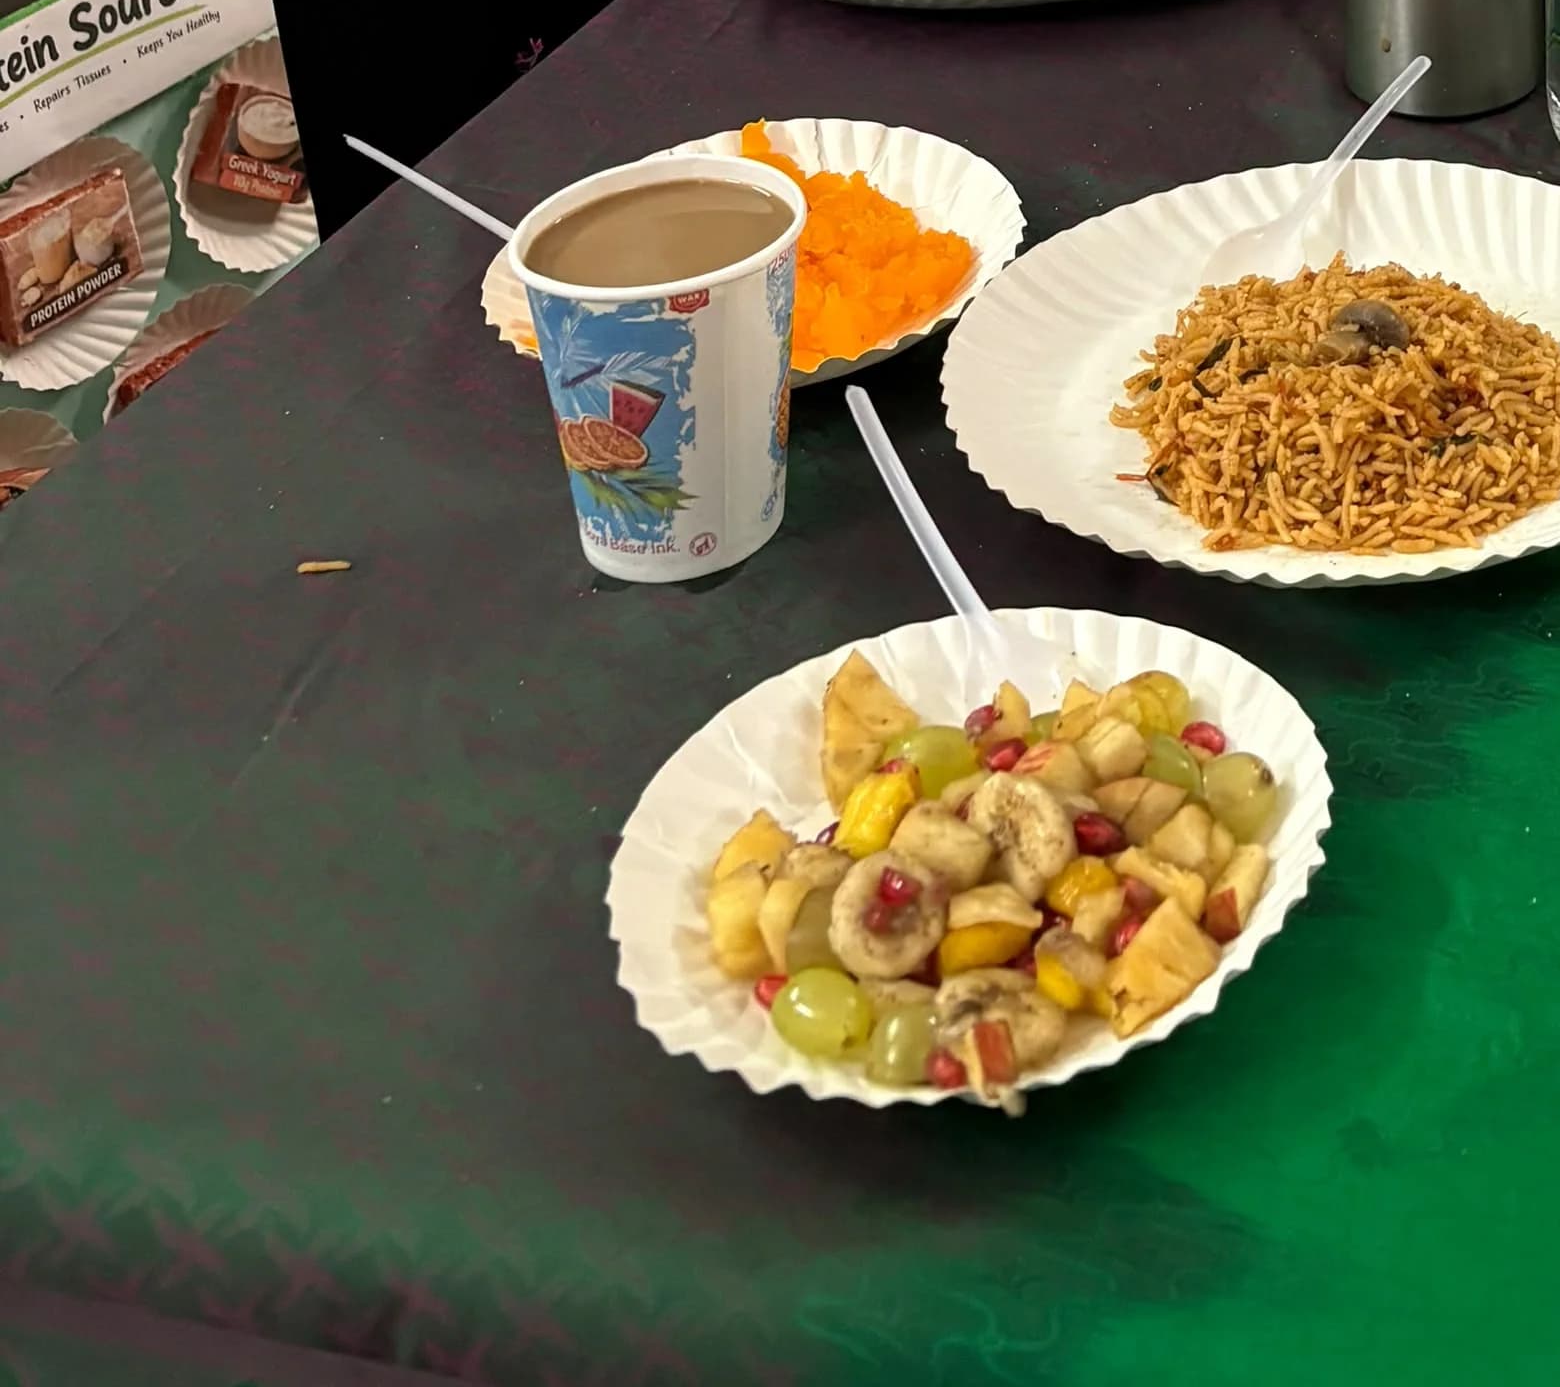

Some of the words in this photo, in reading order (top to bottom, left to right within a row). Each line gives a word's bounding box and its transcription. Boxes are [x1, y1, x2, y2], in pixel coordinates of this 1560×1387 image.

[136, 38, 164, 58] Keeps
[166, 26, 183, 43] You
[186, 10, 221, 36] Healthy
[33, 84, 71, 113] Repairs
[30, 290, 76, 328] PROTEIN
[76, 263, 122, 299] POWDER
